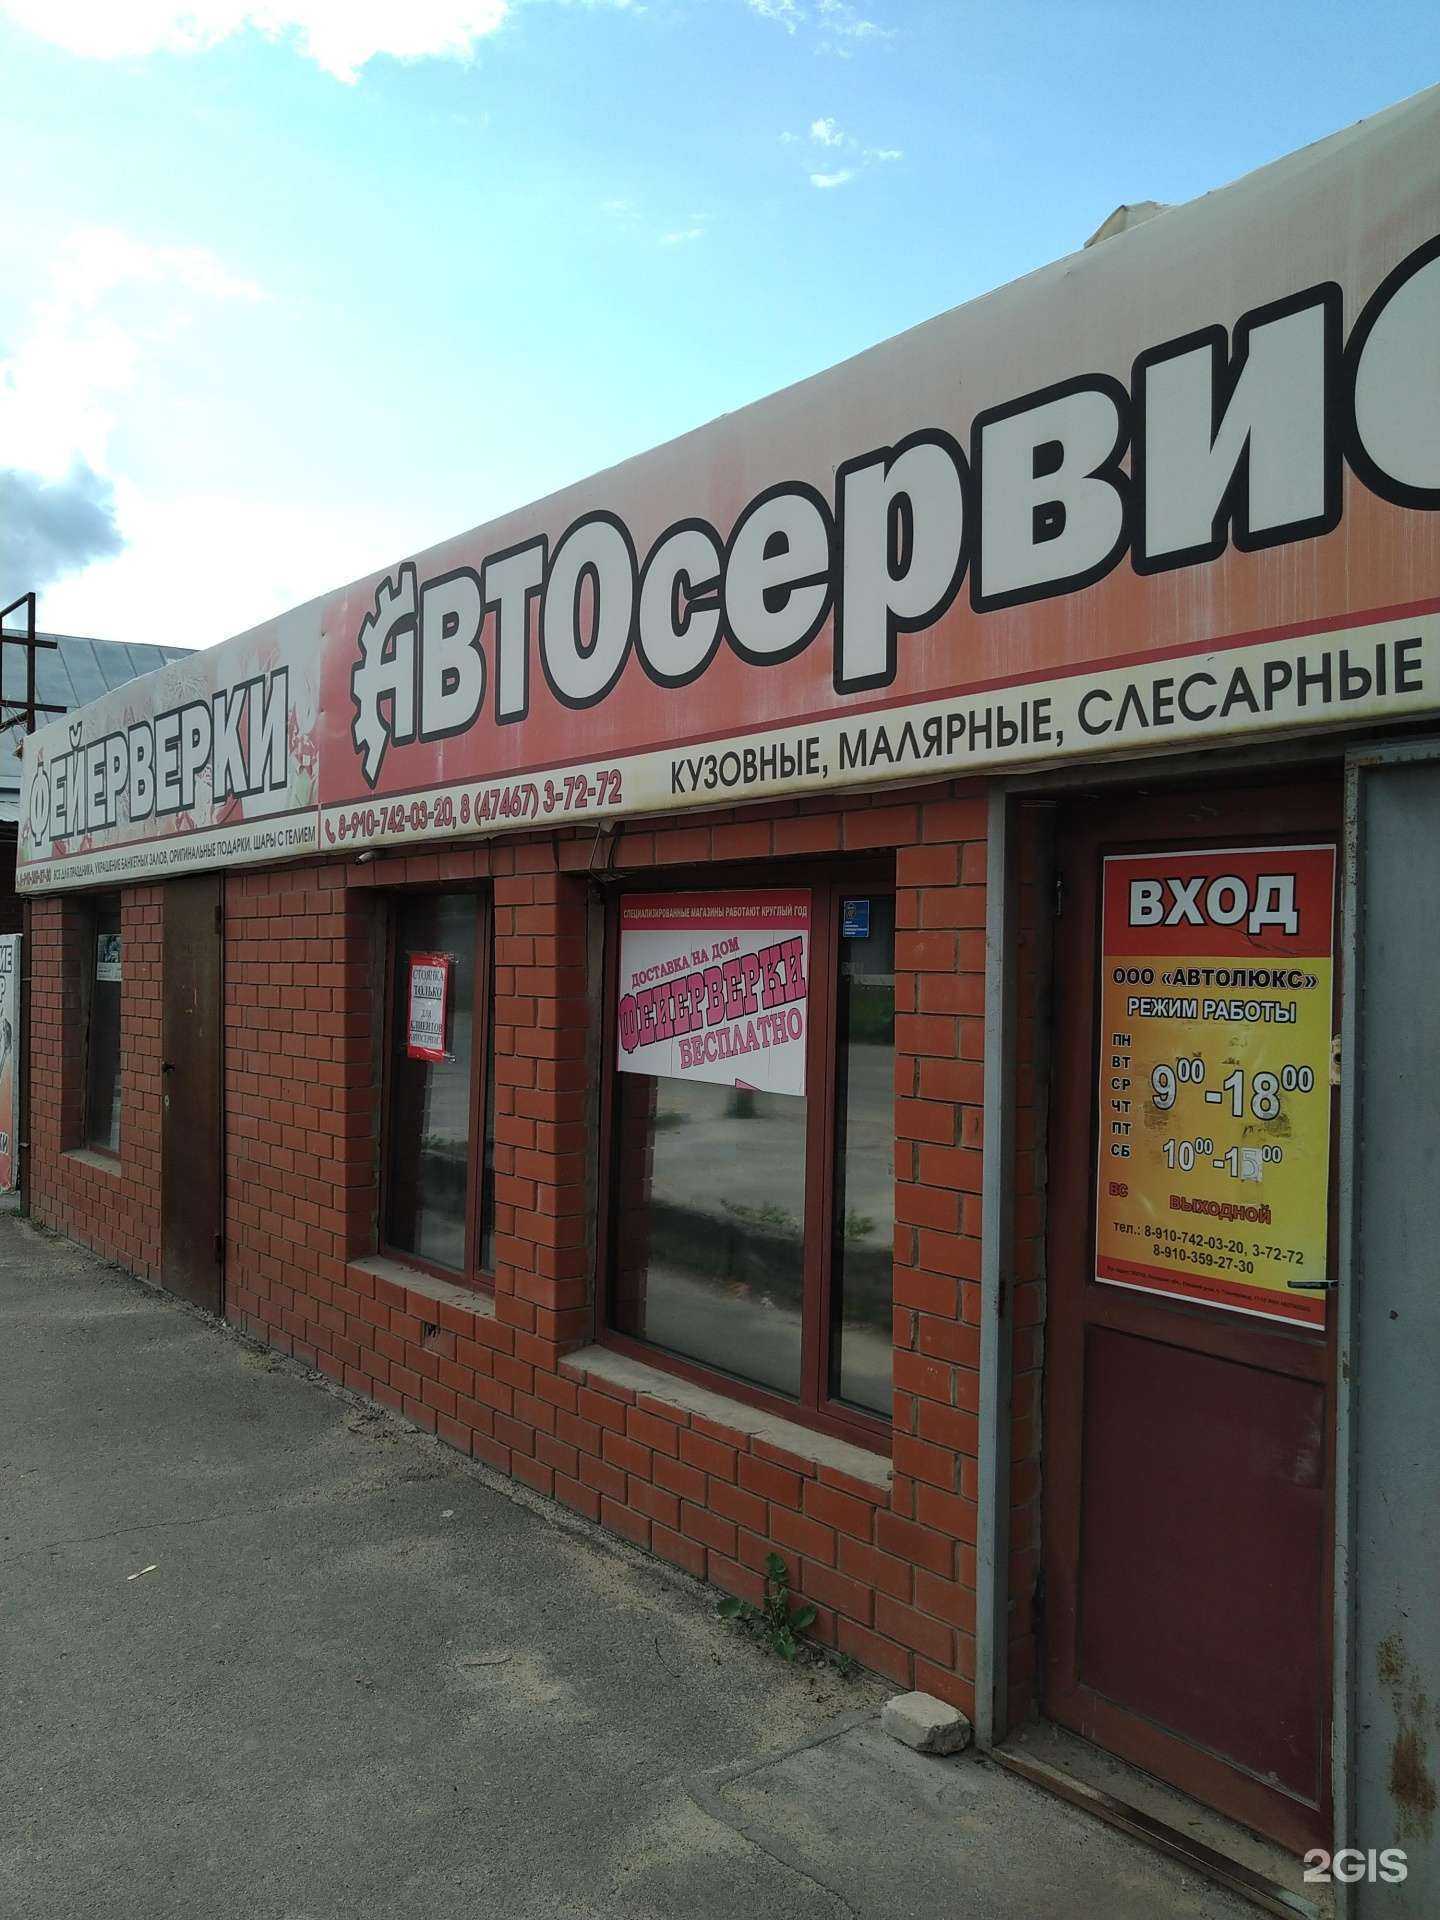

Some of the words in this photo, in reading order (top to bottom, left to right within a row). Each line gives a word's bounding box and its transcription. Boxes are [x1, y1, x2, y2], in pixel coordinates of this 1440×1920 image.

[671, 736, 828, 794] КУЗОВНЫЕ,
[839, 698, 1064, 770] МАЛЯРНЫЕ,
[1078, 637, 1423, 735] СЛЕСАРНЫЕ
[29, 665, 289, 847] ФЕЙЕРВЕРКИ
[338, 796, 456, 840] 8-910-742-03-20,
[460, 794, 471, 824] 8
[474, 782, 540, 826] (47467)
[543, 769, 622, 813] 3-72-72
[169, 843, 216, 865] ОРИГИНАЛЬНЫЕ
[253, 832, 277, 850] ШАРЫ
[278, 830, 284, 846] С
[285, 826, 316, 846] ГЕЛИЕМ
[623, 907, 689, 919] СПЕЦИАЛИЗИРОВАННЫЕ
[690, 906, 725, 918] МАГАЗИНЫ
[725, 905, 760, 918] РАБОТАЮТ
[761, 903, 792, 918] КРУГЛЫЙ
[793, 905, 808, 918] ГОД
[1129, 874, 1299, 936] ВХОД
[632, 956, 690, 989] ДОСТАВКА
[692, 948, 709, 966] НА
[711, 936, 740, 961] ДОМ
[414, 984, 442, 998] ТОЛЬКО
[1111, 967, 1154, 986] ООО
[1161, 967, 1319, 989] «АВТОЛЮКС»
[1127, 996, 1198, 1019] РЕЖИМ
[1202, 1000, 1297, 1023] РАБОТЫ
[679, 1007, 803, 1069] БЕСПЛАТНО
[1111, 1033, 1132, 1047] ПН
[1111, 1056, 1131, 1069] ВТ
[1111, 1078, 1131, 1091] СР
[1111, 1100, 1131, 1113] ЧТ
[1111, 1122, 1132, 1135] ПТ
[1111, 1144, 1131, 1158] СБ
[1109, 1182, 1128, 1198] ВС
[1169, 1194, 1272, 1225] ВЫХОДНОЙ
[1112, 1221, 1141, 1236] тел.:
[1144, 1224, 1248, 1257] 8-910-742-03-20,
[1252, 1243, 1305, 1265] 3-72-72
[1152, 1243, 1255, 1274] 8-910-359-27-30
